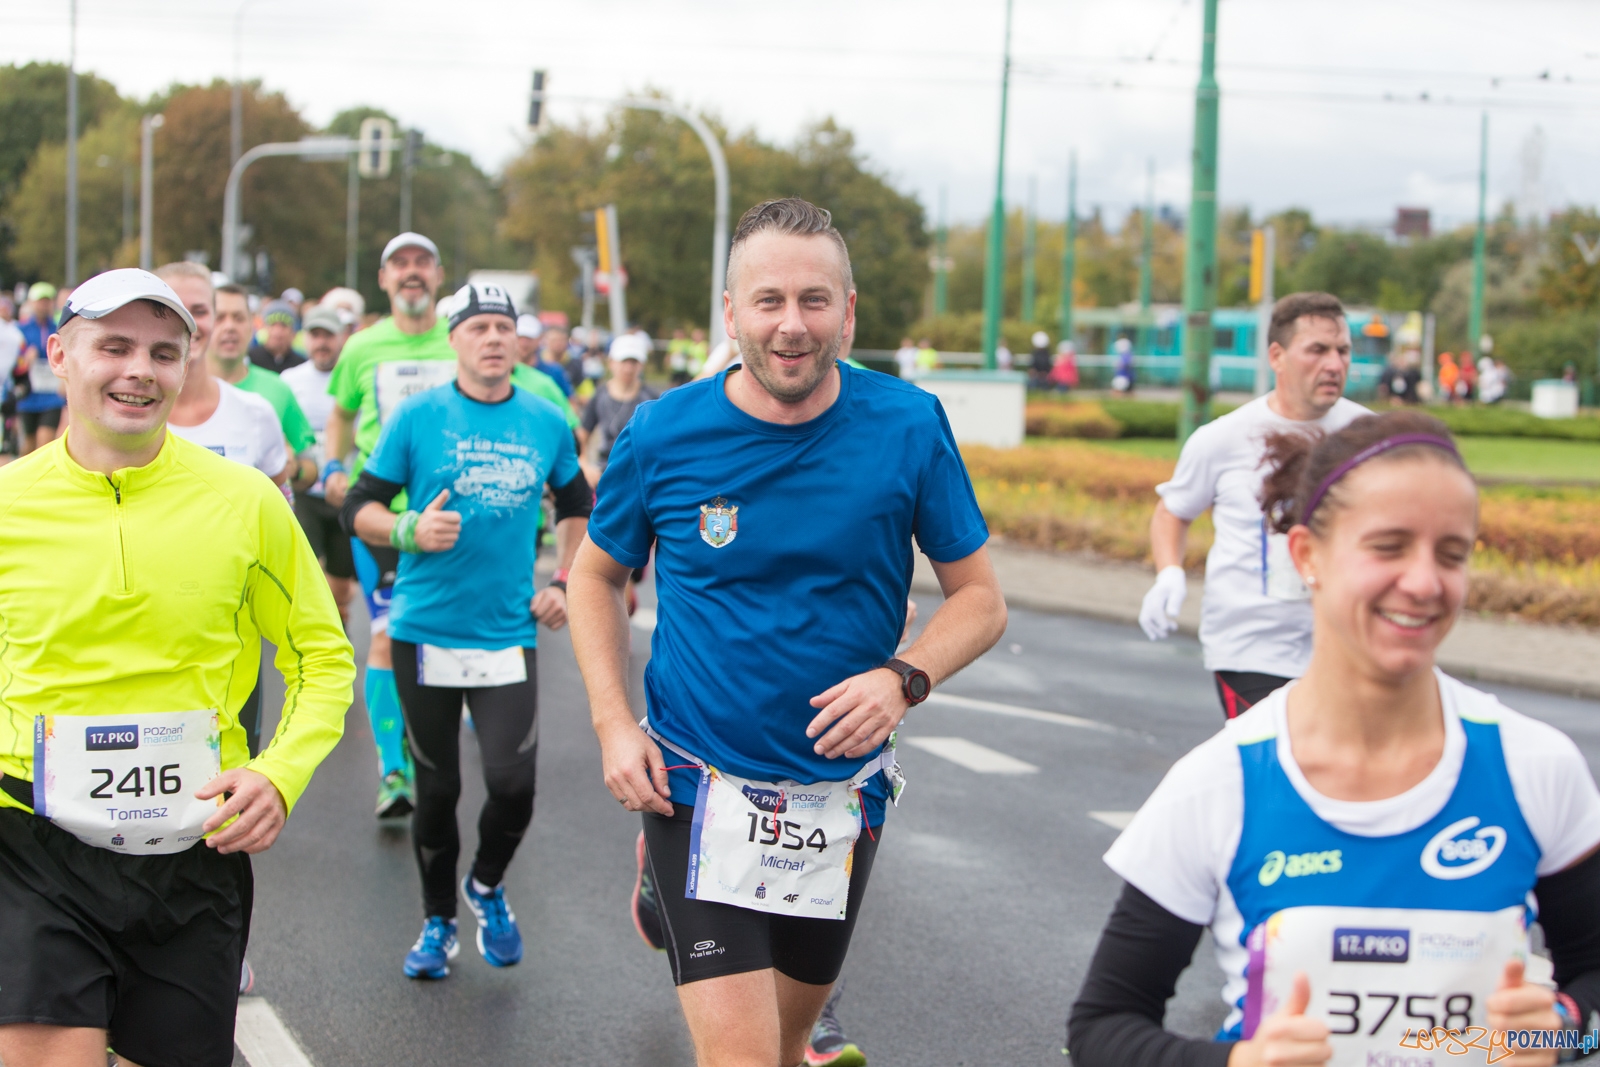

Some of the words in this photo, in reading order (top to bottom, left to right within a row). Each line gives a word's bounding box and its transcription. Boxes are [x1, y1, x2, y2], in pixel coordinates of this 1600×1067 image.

[90, 733, 107, 744] 17.
[108, 731, 135, 744] PKO
[143, 734, 183, 744] maraton
[89, 763, 182, 799] 2416
[746, 792, 759, 804] 17.
[761, 795, 784, 807] PKO
[106, 807, 168, 821] Tomasz
[747, 811, 828, 853] 1954
[145, 837, 164, 846] 4F
[760, 854, 806, 872] Michał
[1284, 848, 1344, 878] asics
[783, 893, 799, 903] 4F
[690, 946, 726, 959] Kalenji
[1337, 934, 1365, 954] 17.
[1366, 935, 1406, 956] PKO
[1328, 988, 1474, 1038] 3758
